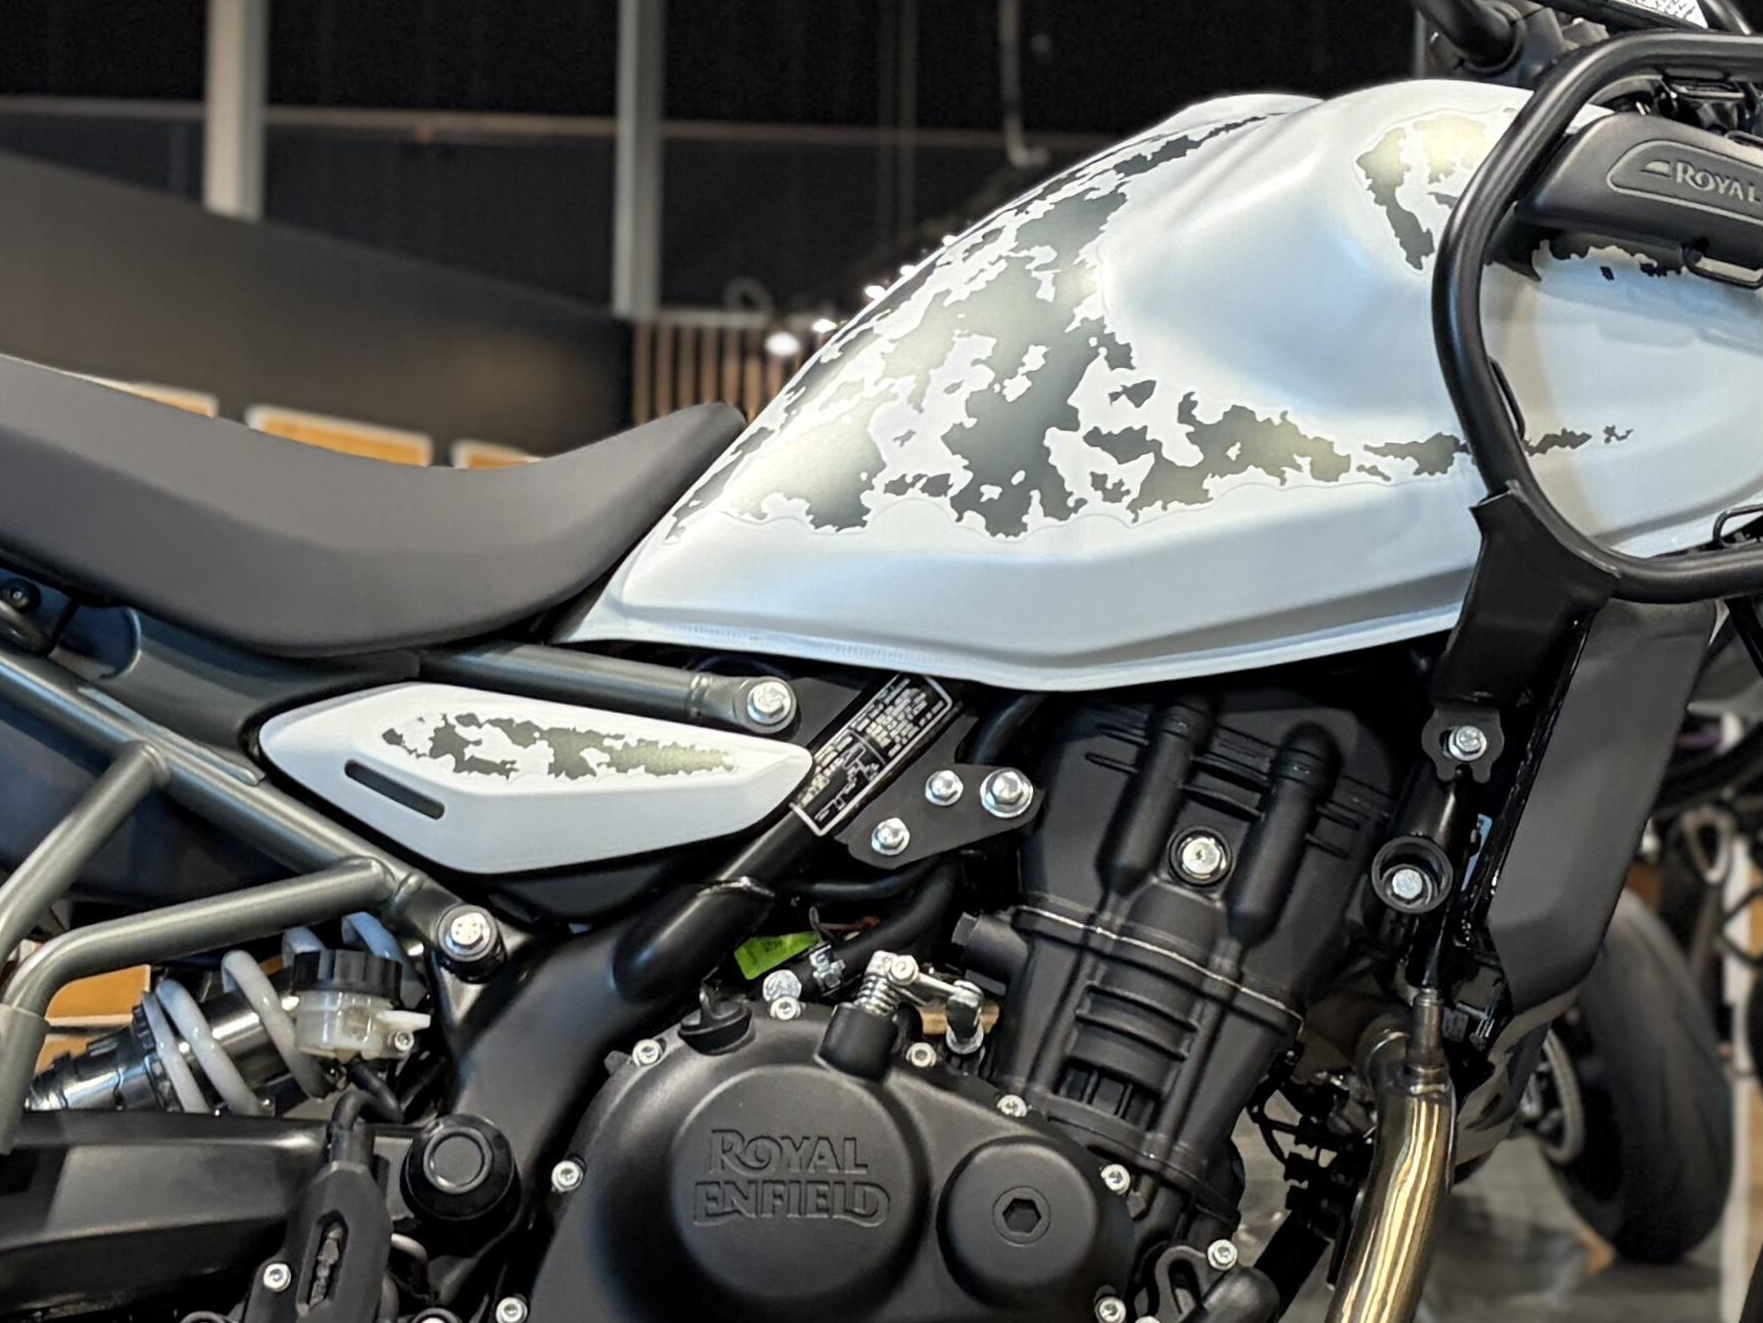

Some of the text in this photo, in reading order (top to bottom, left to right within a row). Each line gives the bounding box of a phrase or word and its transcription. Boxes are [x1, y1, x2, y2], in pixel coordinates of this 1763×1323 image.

[1675, 158, 1761, 204] ROYAL
[709, 1129, 869, 1177] ROYAL
[693, 1180, 891, 1227] ENFIELD
